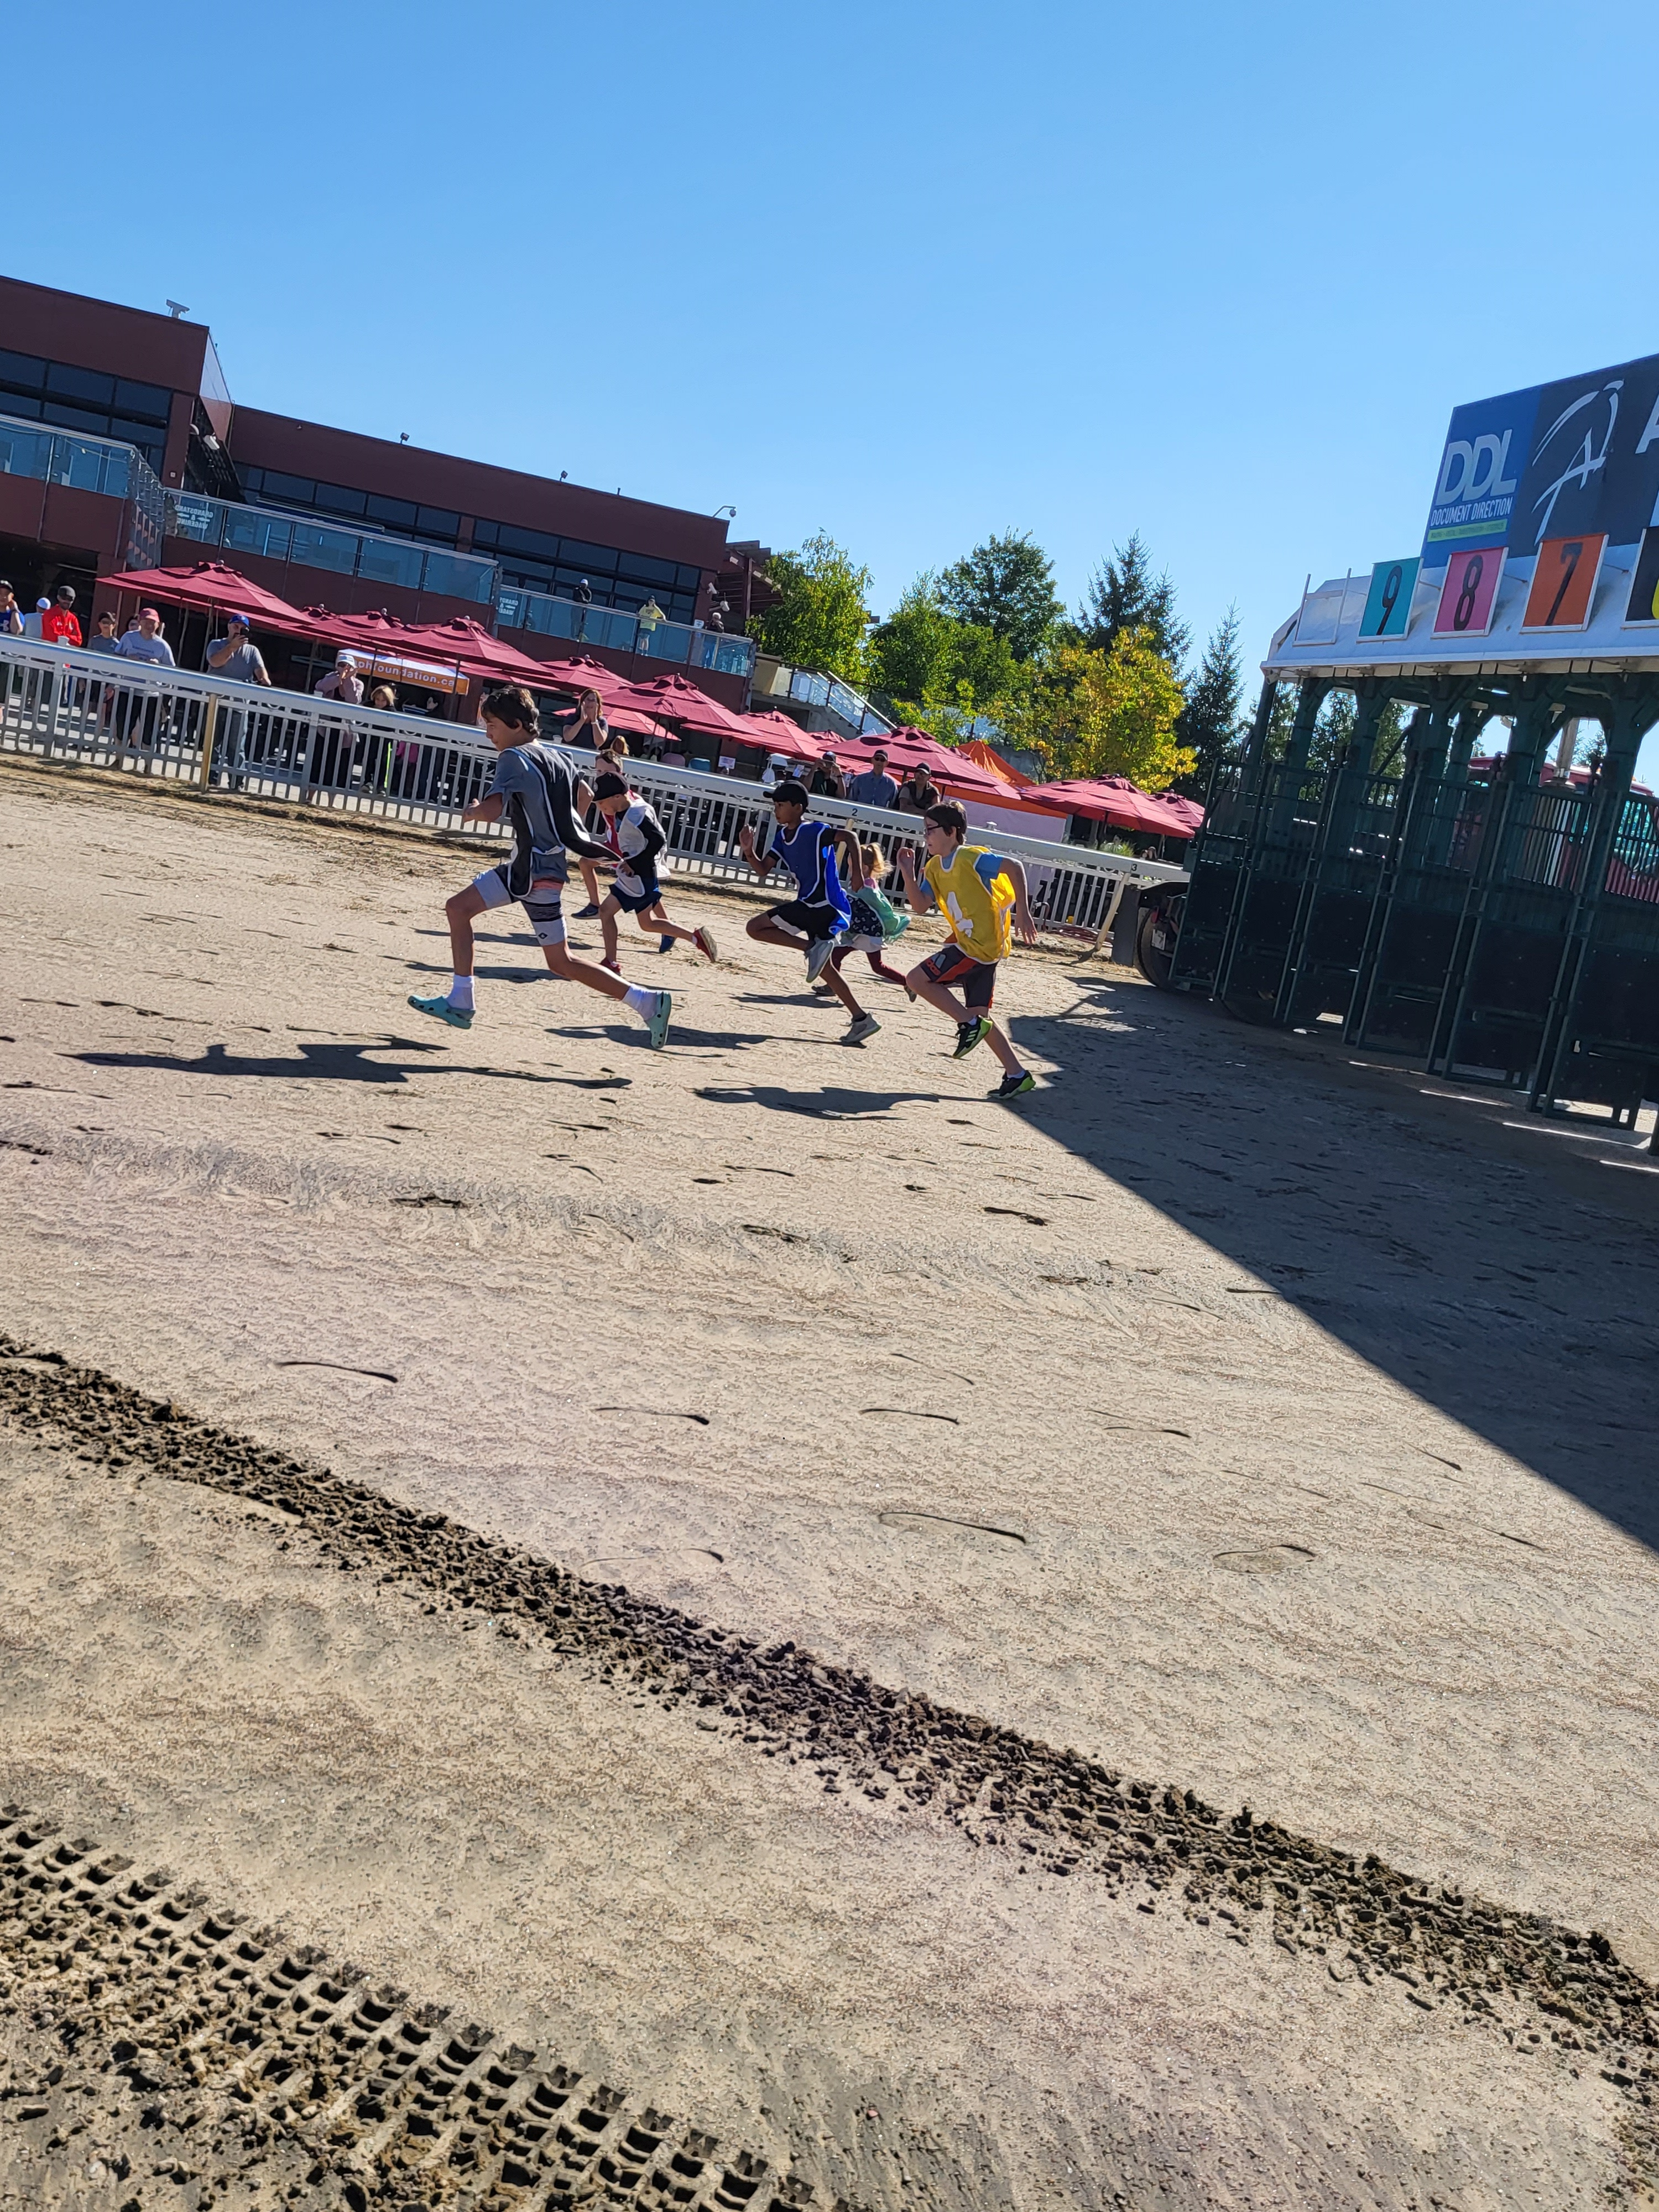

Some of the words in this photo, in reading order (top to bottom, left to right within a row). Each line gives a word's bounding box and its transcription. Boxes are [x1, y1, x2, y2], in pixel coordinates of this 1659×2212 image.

[1436, 429, 1517, 506] DDL
[1431, 504, 1472, 526] DOCUMENT
[1471, 497, 1512, 520] DIRECTION
[1375, 565, 1402, 636] 9
[1454, 555, 1483, 631] 8
[1545, 541, 1583, 626] 7
[852, 808, 858, 817] 2
[1131, 863, 1138, 872] 3
[947, 891, 974, 938] 4
